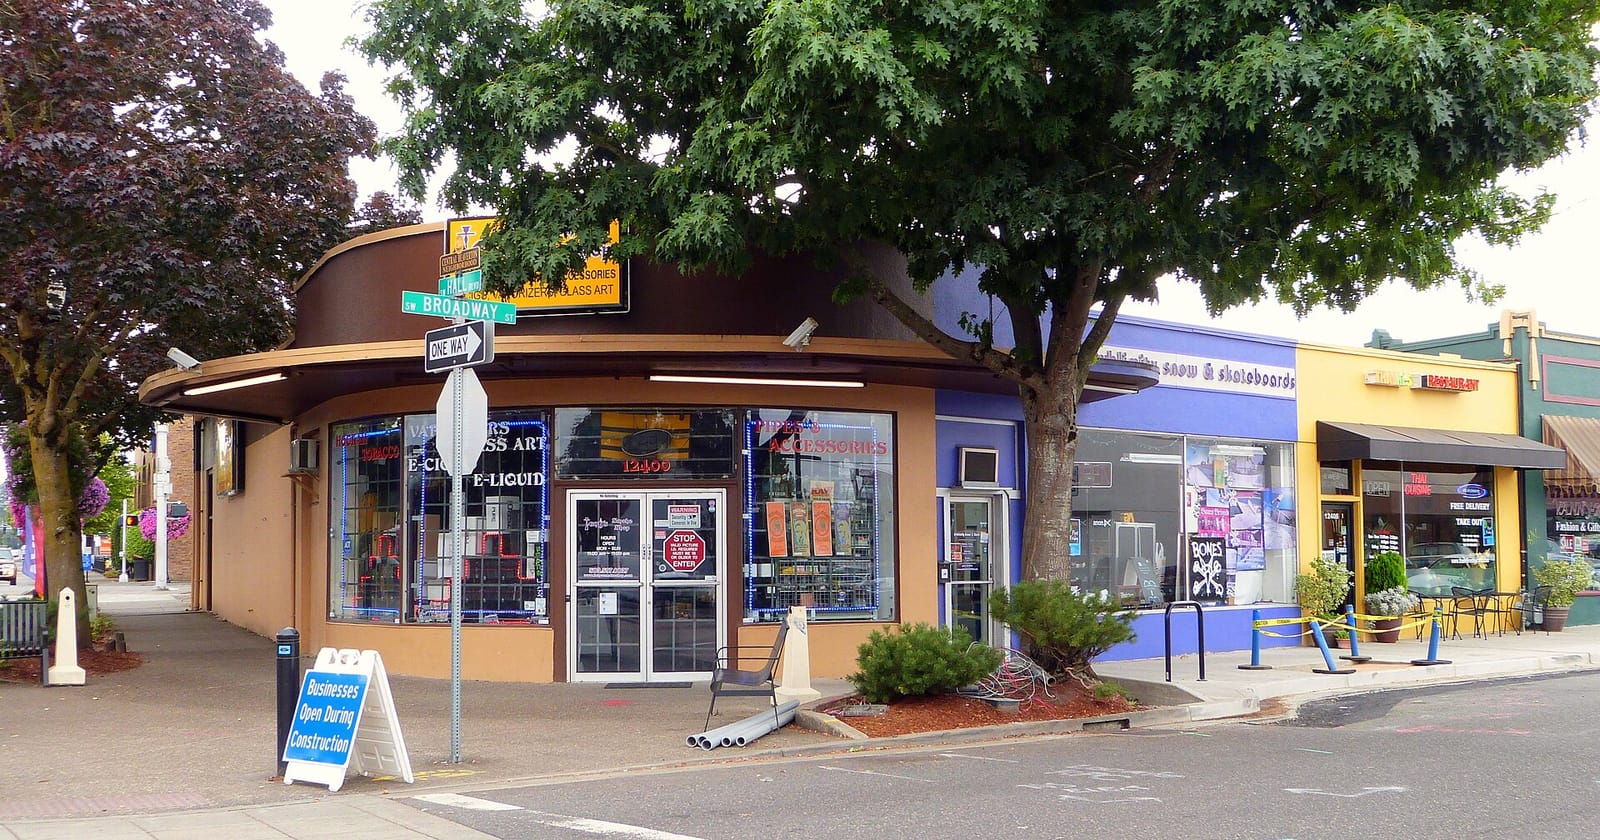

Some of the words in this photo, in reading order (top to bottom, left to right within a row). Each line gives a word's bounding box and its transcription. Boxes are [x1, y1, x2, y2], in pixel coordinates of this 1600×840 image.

[447, 274, 467, 295] HALL
[594, 284, 615, 295] ART
[405, 302, 416, 311] SW
[423, 296, 498, 319] BROADWAY
[505, 314, 514, 322] ST
[431, 341, 448, 357] ONE
[450, 335, 469, 352] WAY
[1162, 362, 1198, 378] snow
[1218, 364, 1296, 389] skateboards
[1428, 374, 1480, 392] RESTAURANT
[754, 420, 801, 434] PIPES
[513, 437, 547, 451] ART
[768, 439, 888, 455] ACCESSORIES
[362, 446, 399, 461] TOBACCO
[623, 460, 671, 473] 12400
[474, 472, 544, 487] E-LIQUID
[1411, 473, 1427, 483] THAI
[1405, 484, 1431, 496] CUISINE
[1450, 502, 1465, 510] FREE
[1465, 502, 1490, 511] DELIVERY
[1456, 518, 1471, 526] TAKE
[1472, 518, 1482, 526] OUT
[1556, 521, 1579, 532] Fashion
[1580, 522, 1587, 532] &
[1191, 541, 1223, 557] BONES
[1560, 537, 1573, 550] SALE
[307, 678, 360, 699] Businesses
[299, 703, 322, 724] Open
[323, 705, 354, 730] During
[290, 730, 349, 753] Construction
